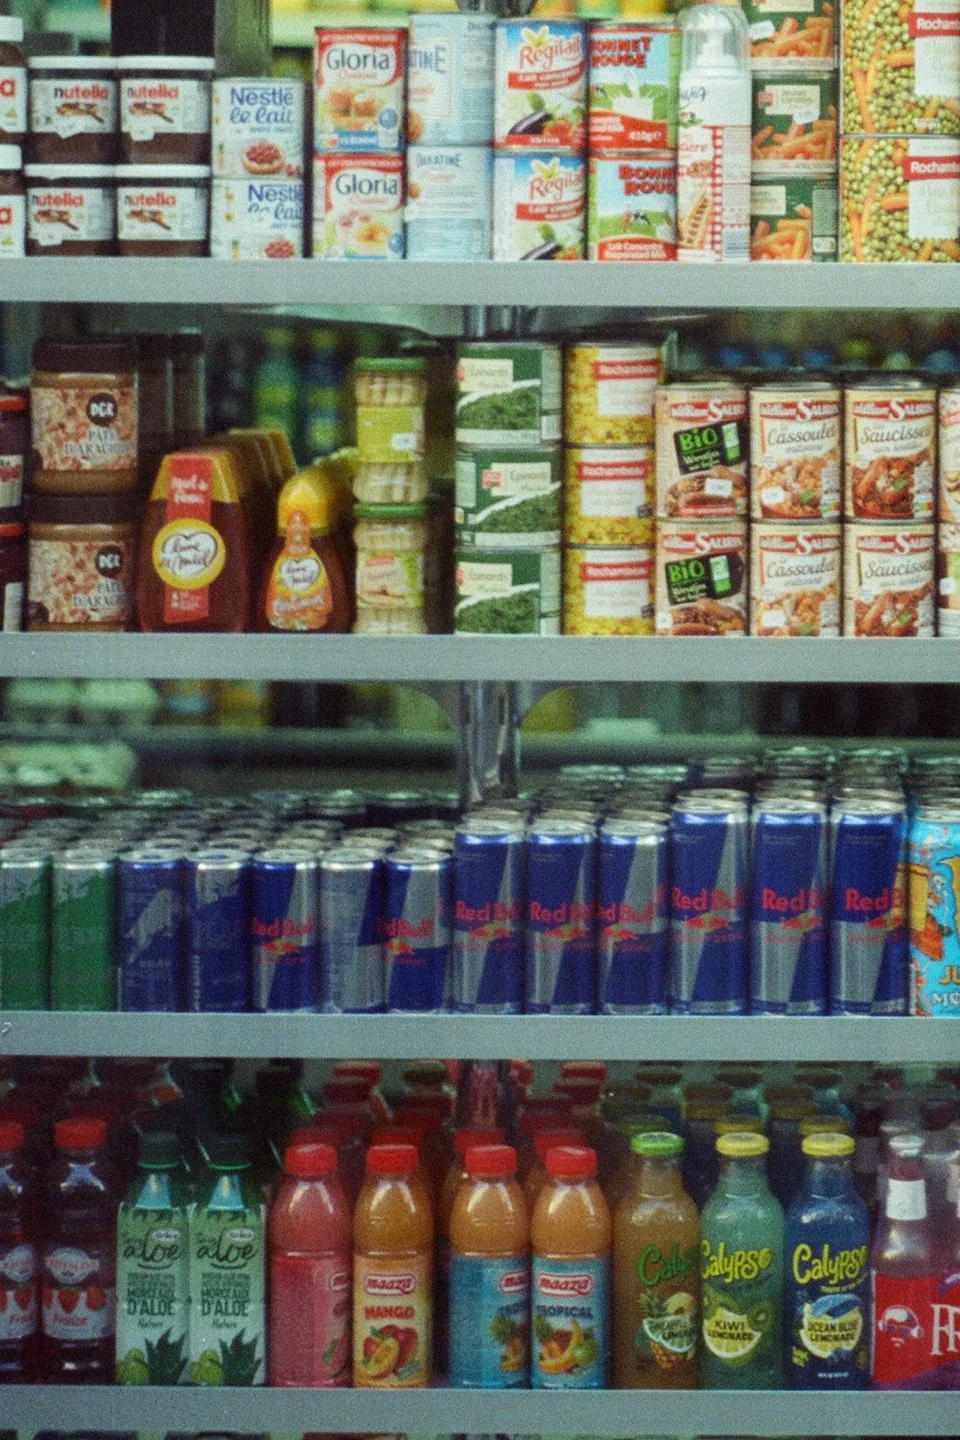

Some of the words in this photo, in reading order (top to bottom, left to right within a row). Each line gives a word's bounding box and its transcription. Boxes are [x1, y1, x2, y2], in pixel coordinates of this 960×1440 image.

[325, 48, 391, 71] Gloria
[53, 85, 109, 100] nutella
[127, 85, 180, 100] nutella
[336, 172, 399, 196] Gloria
[30, 193, 85, 208] nutella
[124, 193, 177, 208] nutella
[761, 889, 804, 912] Red
[846, 889, 888, 912] Red
[530, 901, 566, 921] Red
[364, 1305, 416, 1321] MANGO
[715, 1319, 745, 1331] KIWI
